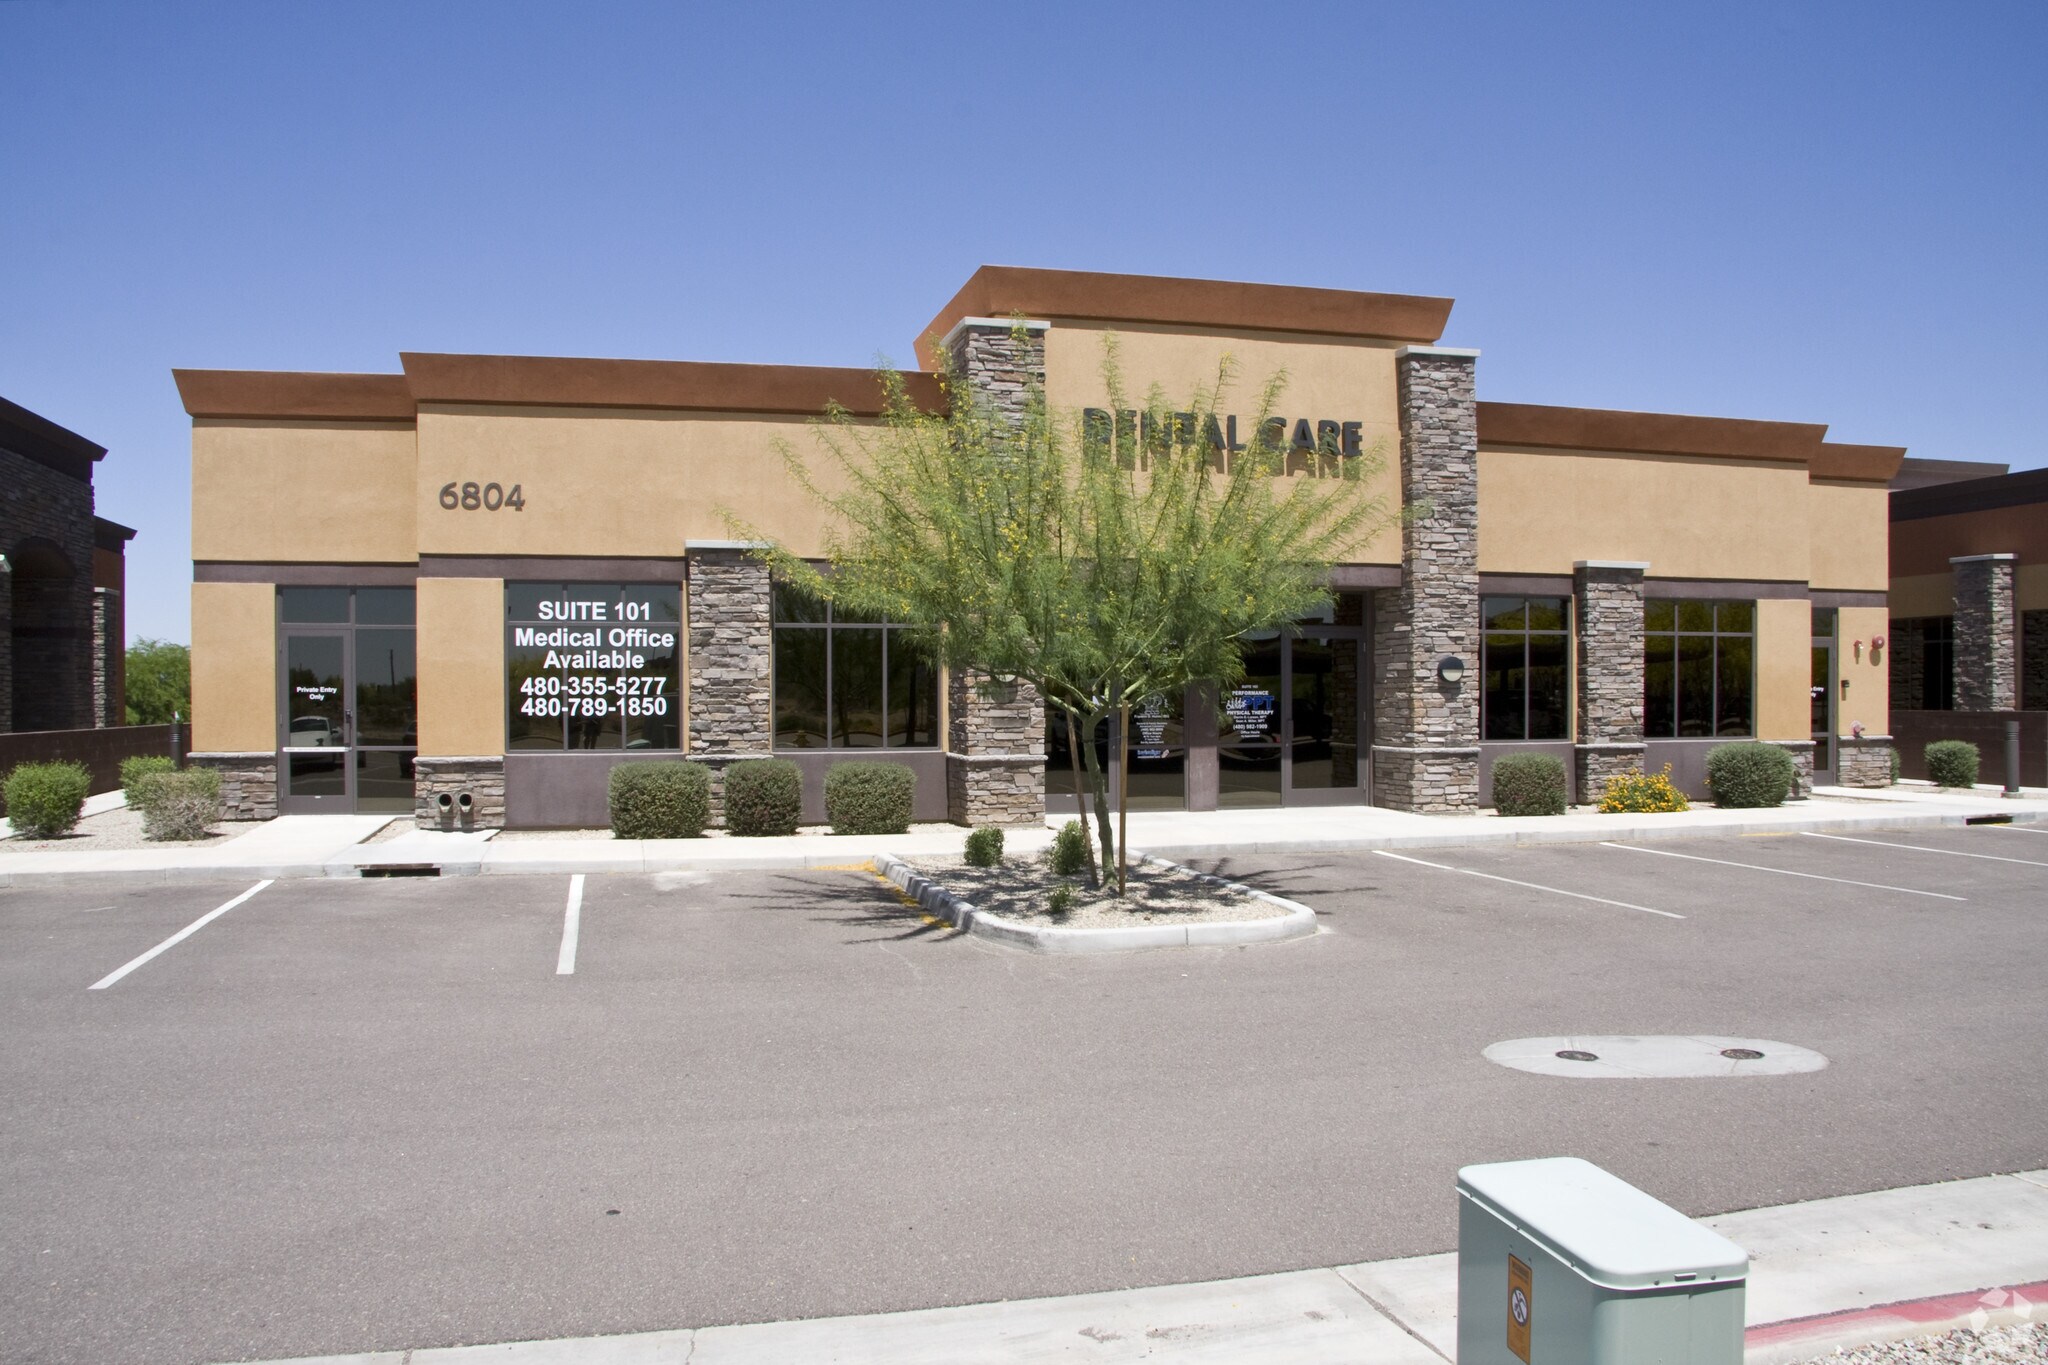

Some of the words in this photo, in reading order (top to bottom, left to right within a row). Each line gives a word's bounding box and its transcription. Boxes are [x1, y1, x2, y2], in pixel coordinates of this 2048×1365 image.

[1259, 417, 1363, 457] CARE
[439, 481, 526, 512] 6804
[538, 601, 607, 621] SUITE
[615, 602, 650, 621] 101
[515, 628, 601, 647] Medical
[608, 629, 675, 648] Office
[543, 651, 645, 669] Available
[319, 686, 337, 694] Entry
[520, 677, 667, 696] 480-355-5277
[309, 693, 325, 701] Only
[1243, 695, 1275, 710] PPT
[520, 698, 667, 717] 480-789-1850
[1232, 723, 1246, 731] (480)
